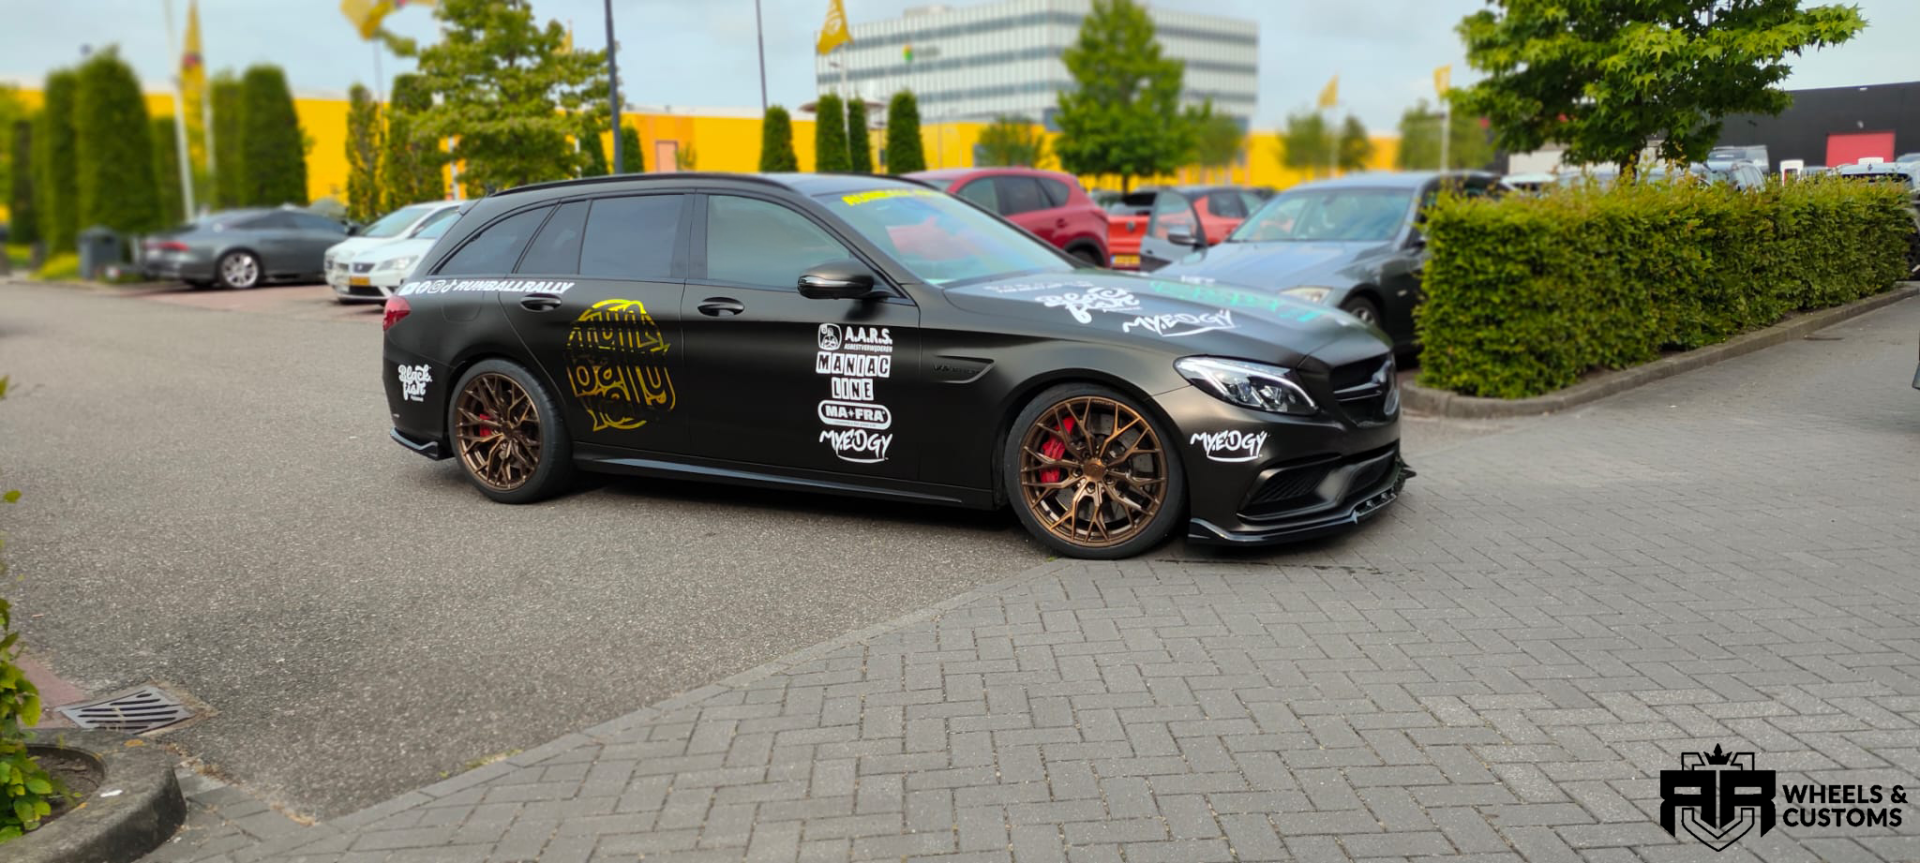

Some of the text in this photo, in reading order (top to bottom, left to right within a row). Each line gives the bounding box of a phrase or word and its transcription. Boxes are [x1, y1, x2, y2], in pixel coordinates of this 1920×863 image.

[453, 280, 574, 294] RUNBALLRALLY
[844, 326, 893, 345] A.A.R.S.
[816, 352, 891, 378] MANIAC
[831, 377, 874, 400] LINE
